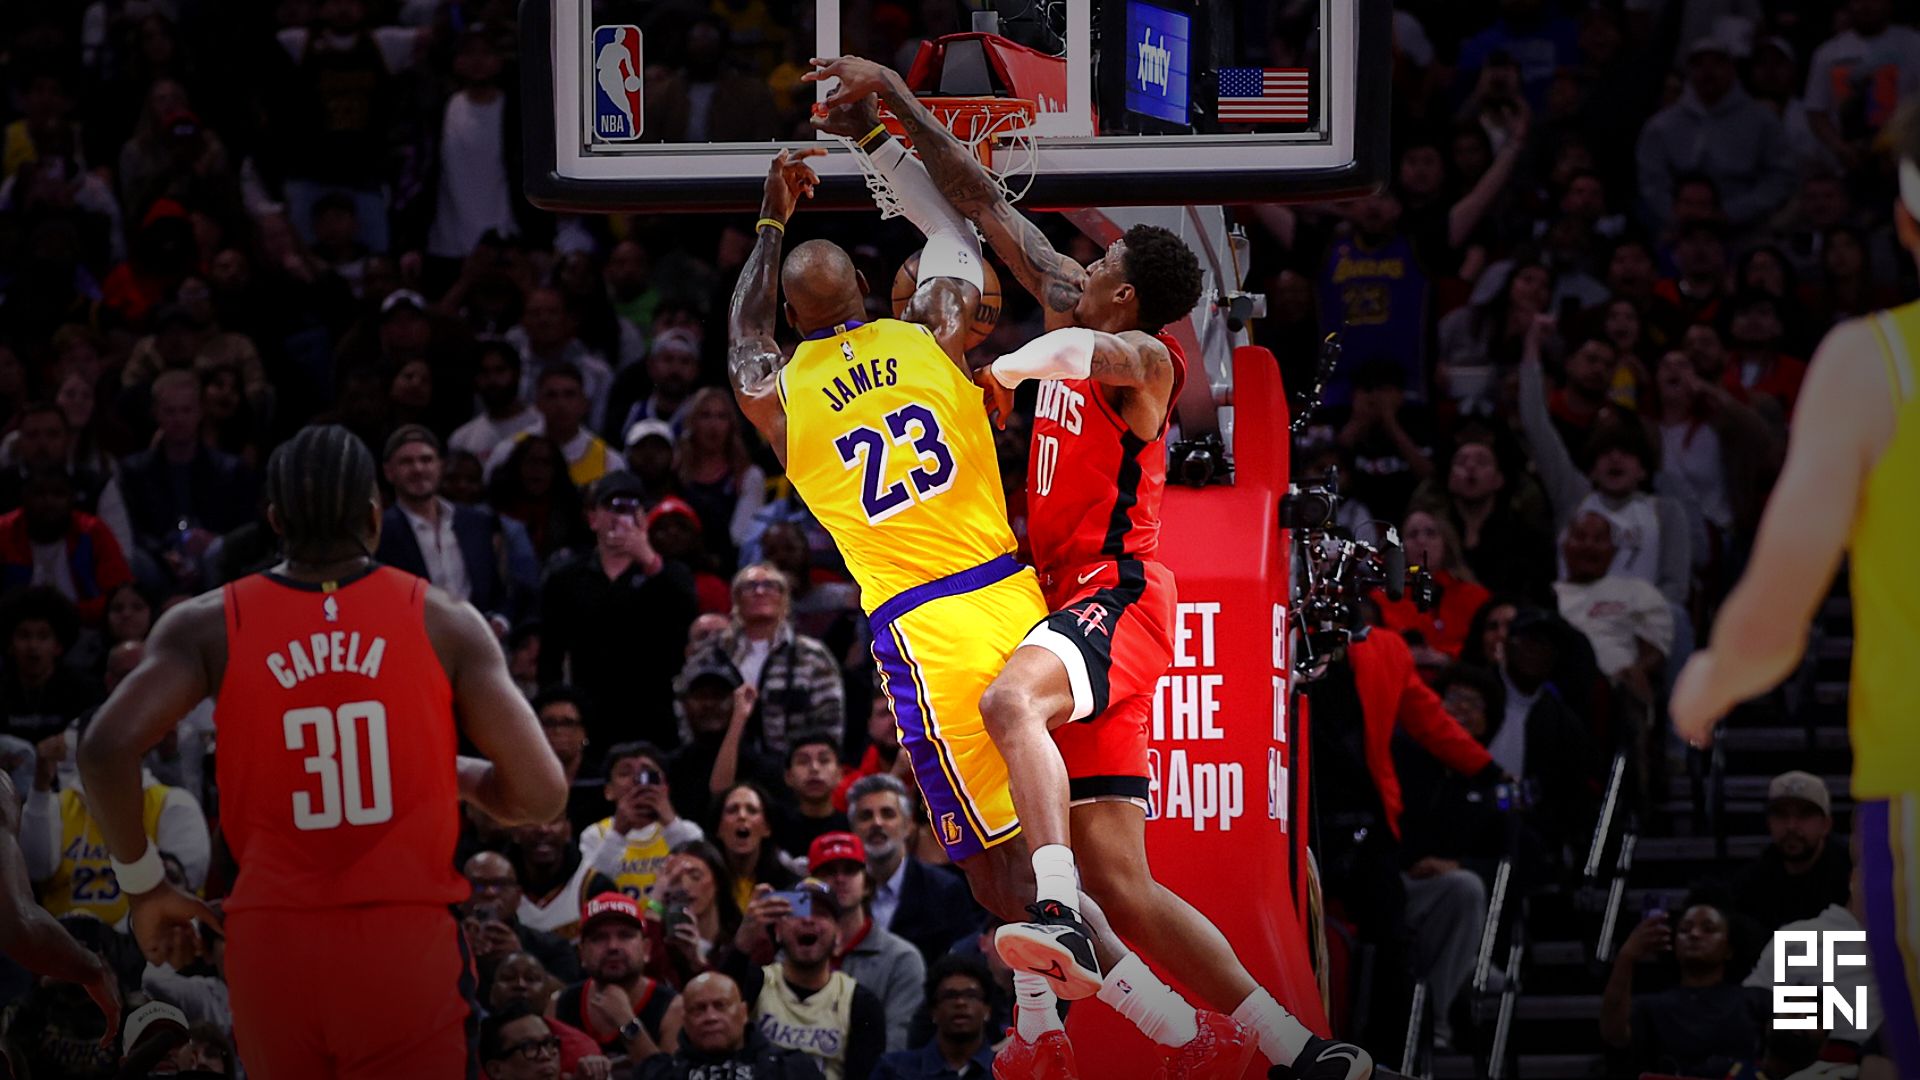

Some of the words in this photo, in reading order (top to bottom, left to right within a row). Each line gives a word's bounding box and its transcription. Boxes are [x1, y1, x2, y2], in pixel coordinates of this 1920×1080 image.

[1137, 26, 1171, 96] xfinity
[600, 114, 625, 133] NBA
[822, 358, 897, 412] JAMES
[832, 402, 958, 526] 23
[1035, 433, 1059, 497] 10
[266, 630, 387, 690] CAPELA
[1166, 602, 1221, 668] ET
[1152, 674, 1225, 741] THE
[282, 699, 394, 831] 30
[1166, 749, 1244, 832] App
[73, 866, 120, 900] 23
